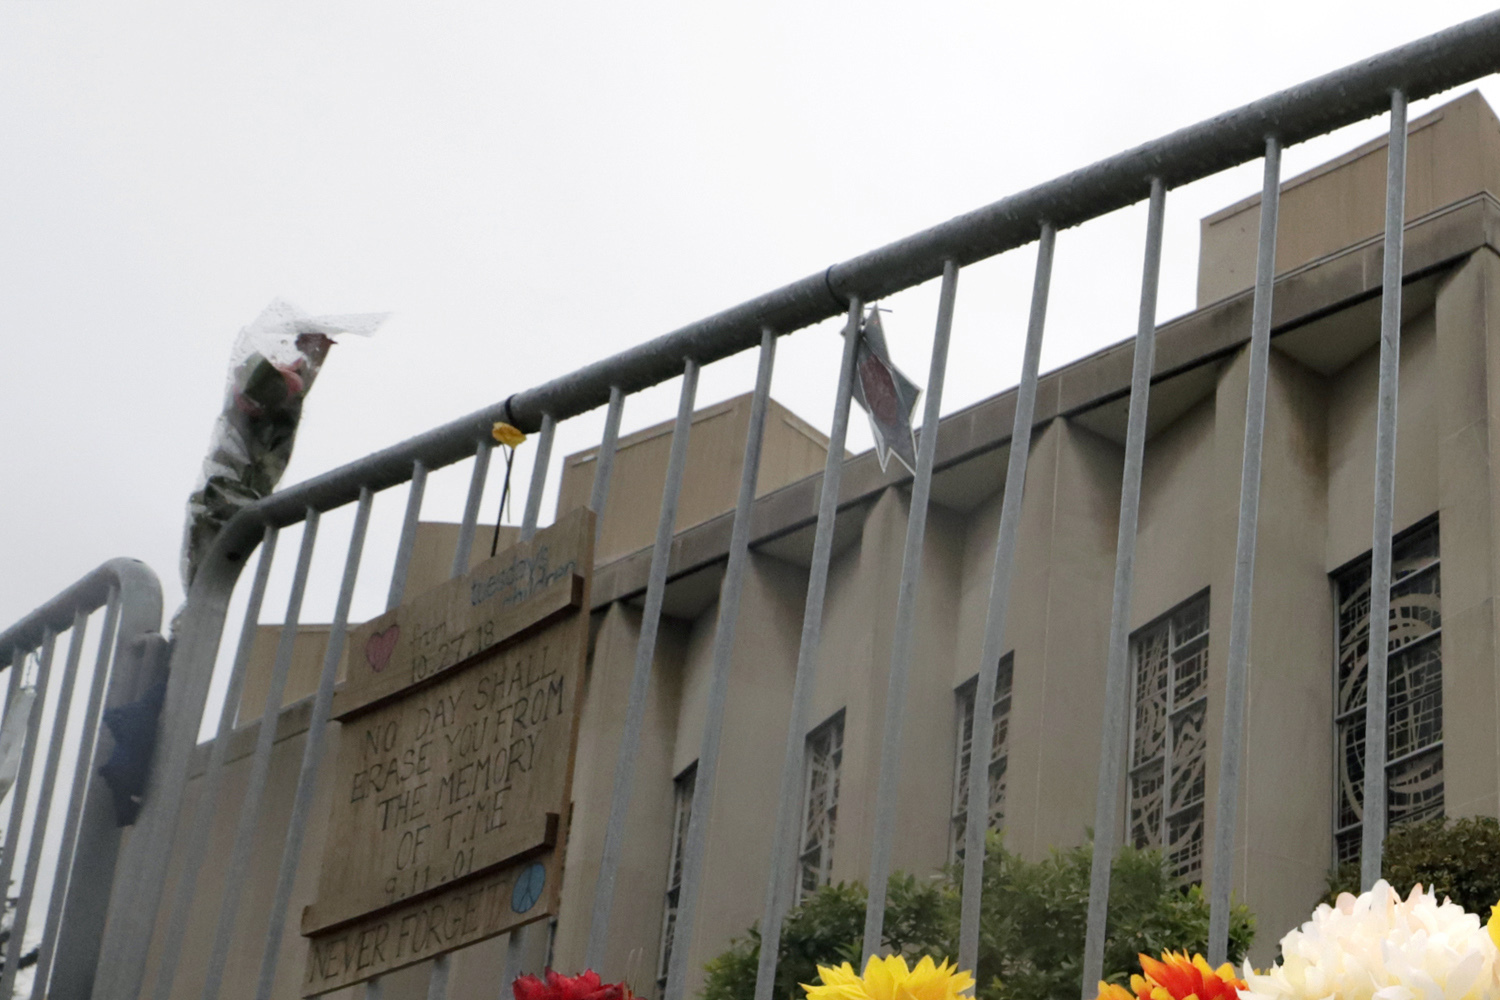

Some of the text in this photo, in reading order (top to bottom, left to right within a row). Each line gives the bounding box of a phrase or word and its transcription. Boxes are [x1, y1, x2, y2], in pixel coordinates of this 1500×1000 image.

[350, 674, 565, 804] ERASE YOU FROM
[364, 646, 557, 761] NO DAY SHALL
[377, 728, 542, 833] THE MEMORY
[395, 785, 513, 873] OF TIME
[308, 879, 508, 985] NEVER FORGET
